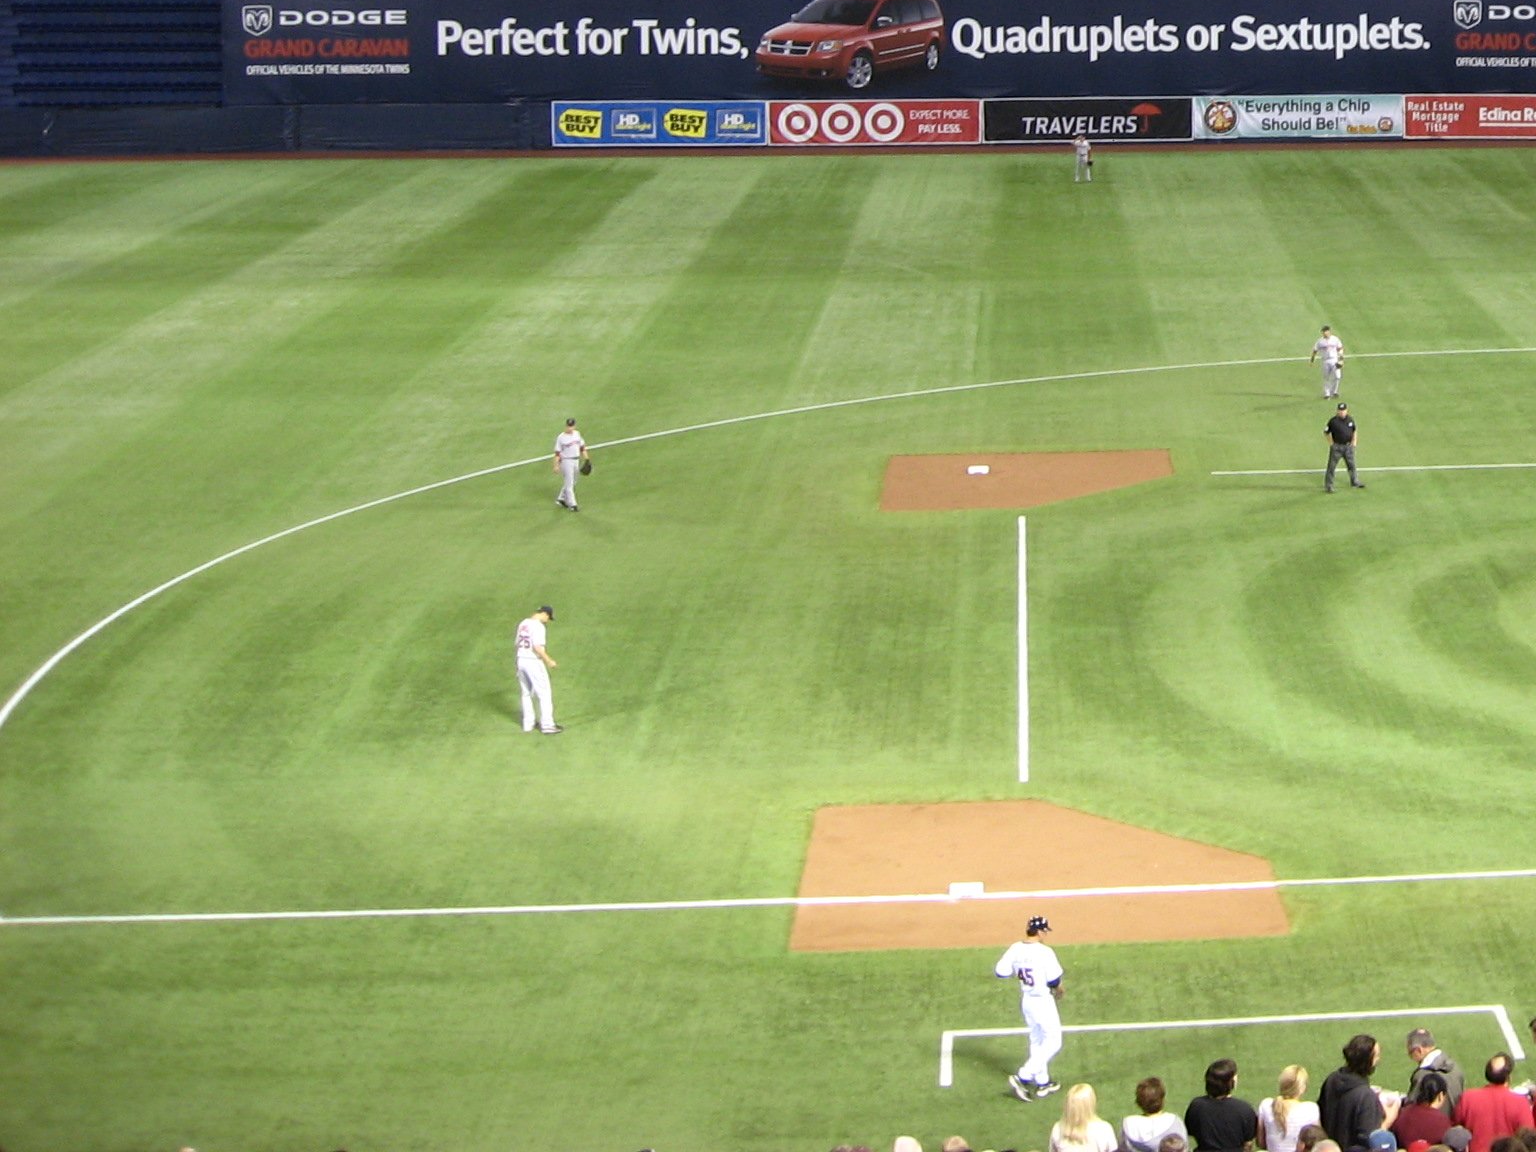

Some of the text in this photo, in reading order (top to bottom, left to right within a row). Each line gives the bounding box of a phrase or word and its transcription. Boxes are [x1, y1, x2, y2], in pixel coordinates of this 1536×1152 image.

[279, 10, 407, 25] DODGE
[437, 17, 749, 59] Perfect for Twins,
[951, 13, 1431, 62] Quadruplets or Sextuplets.
[1455, 33, 1521, 51] GRAND
[245, 38, 410, 58] GRAND CARAVAN
[1456, 57, 1486, 67] OFFICIAL
[1487, 57, 1519, 67] VEHICLES
[1520, 57, 1531, 67] OF
[246, 64, 278, 75] OFFICIAL
[279, 64, 313, 75] VEHICLES
[314, 64, 325, 75] OF
[325, 64, 339, 75] THE
[341, 64, 384, 75] MINNESOTA
[1238, 98, 1371, 115] "Everything a Chip
[1408, 101, 1464, 112] Real Estate
[564, 114, 600, 124] BEST
[619, 113, 640, 126] HD
[669, 114, 705, 124] BEST
[724, 113, 744, 126] HD
[909, 109, 941, 120] EXPECT
[1413, 112, 1460, 123] Mortgage
[565, 123, 596, 134] BUY
[670, 123, 701, 134] BUY
[918, 124, 936, 134] PAY
[1022, 115, 1138, 135] TRAVELERS
[1261, 116, 1347, 131] Should Be!"
[1425, 122, 1448, 132] Title
[1018, 968, 1035, 986] 45
